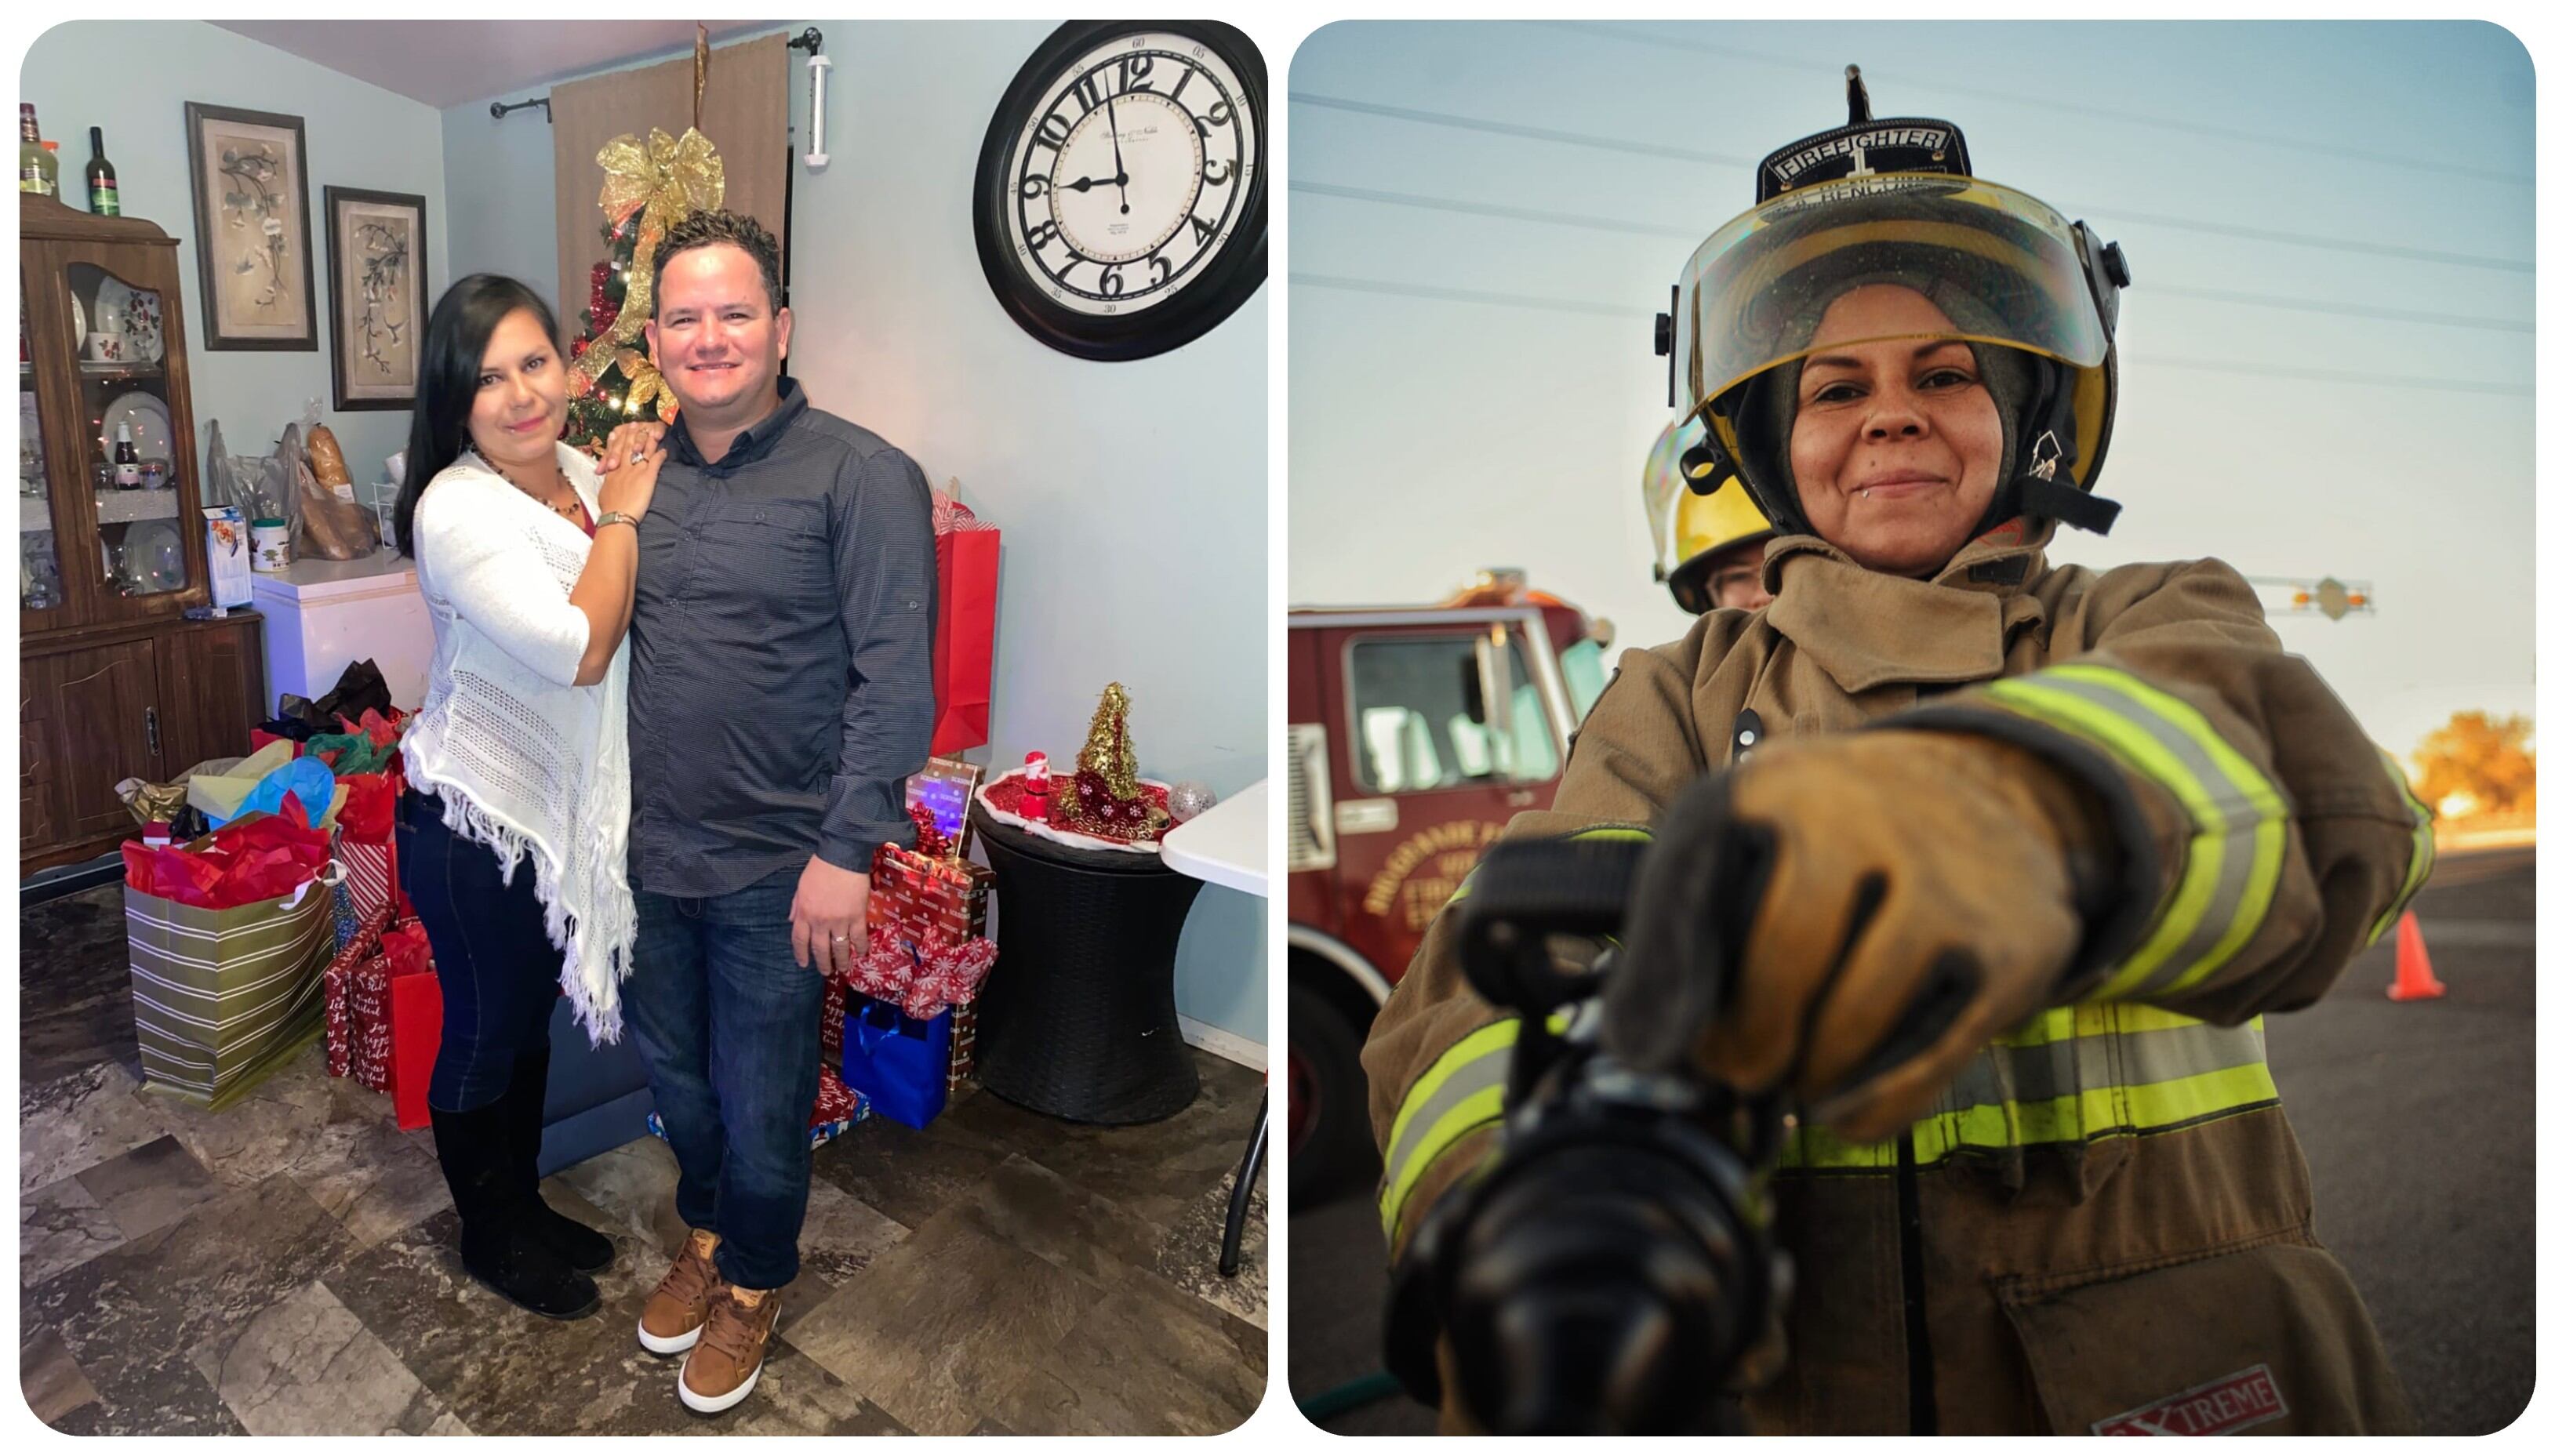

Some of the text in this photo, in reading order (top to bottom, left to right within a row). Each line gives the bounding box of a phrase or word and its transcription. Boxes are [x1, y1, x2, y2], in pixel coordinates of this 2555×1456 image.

[1072, 69, 1102, 113] 11
[1118, 55, 1154, 94] 12
[1170, 66, 1197, 100] 1
[1037, 113, 1071, 152] 10
[1194, 100, 1230, 137] 2
[1777, 128, 1946, 180] FIREFIGHTER
[1023, 173, 1052, 200] 9
[1204, 159, 1237, 186] 3
[1028, 220, 1058, 250] 8
[1190, 213, 1217, 247] 4
[1056, 248, 1089, 282] 7
[1099, 263, 1124, 296] 6
[1147, 248, 1172, 285] 5
[2109, 1377, 2277, 1437] XTREME
